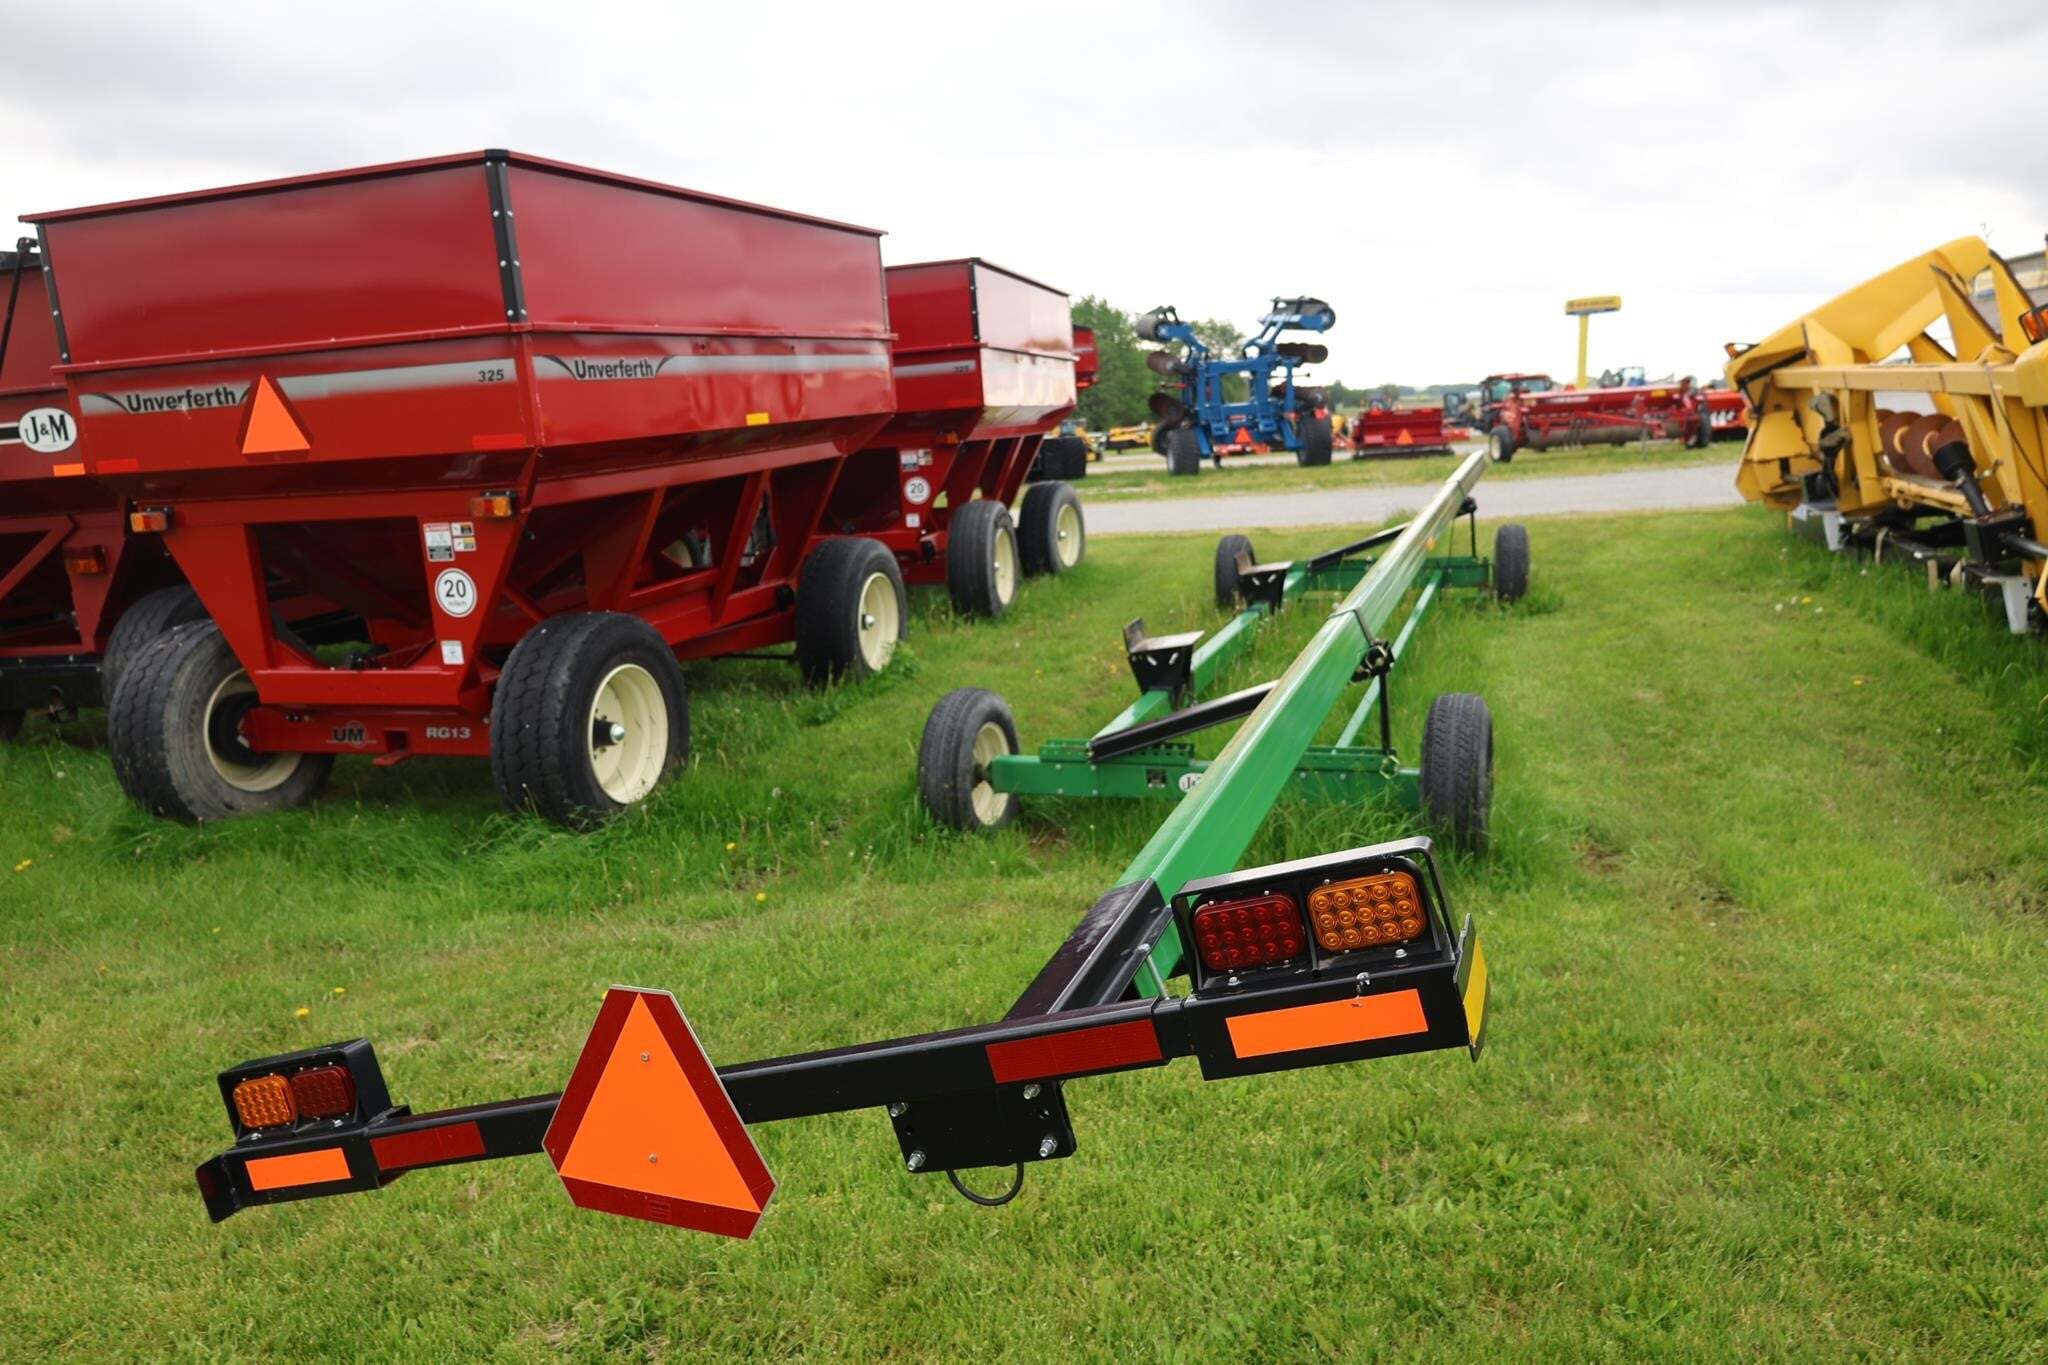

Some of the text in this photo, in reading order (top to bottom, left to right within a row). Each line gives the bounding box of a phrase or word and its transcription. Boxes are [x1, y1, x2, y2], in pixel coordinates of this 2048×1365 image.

[478, 369, 504, 382] 325
[575, 359, 653, 378] Unverferth
[126, 387, 235, 414] Unverferth
[25, 414, 69, 444] J&M
[910, 484, 924, 494] 20
[444, 579, 466, 598] 20
[333, 728, 364, 742] UM
[426, 727, 471, 739] RG13
